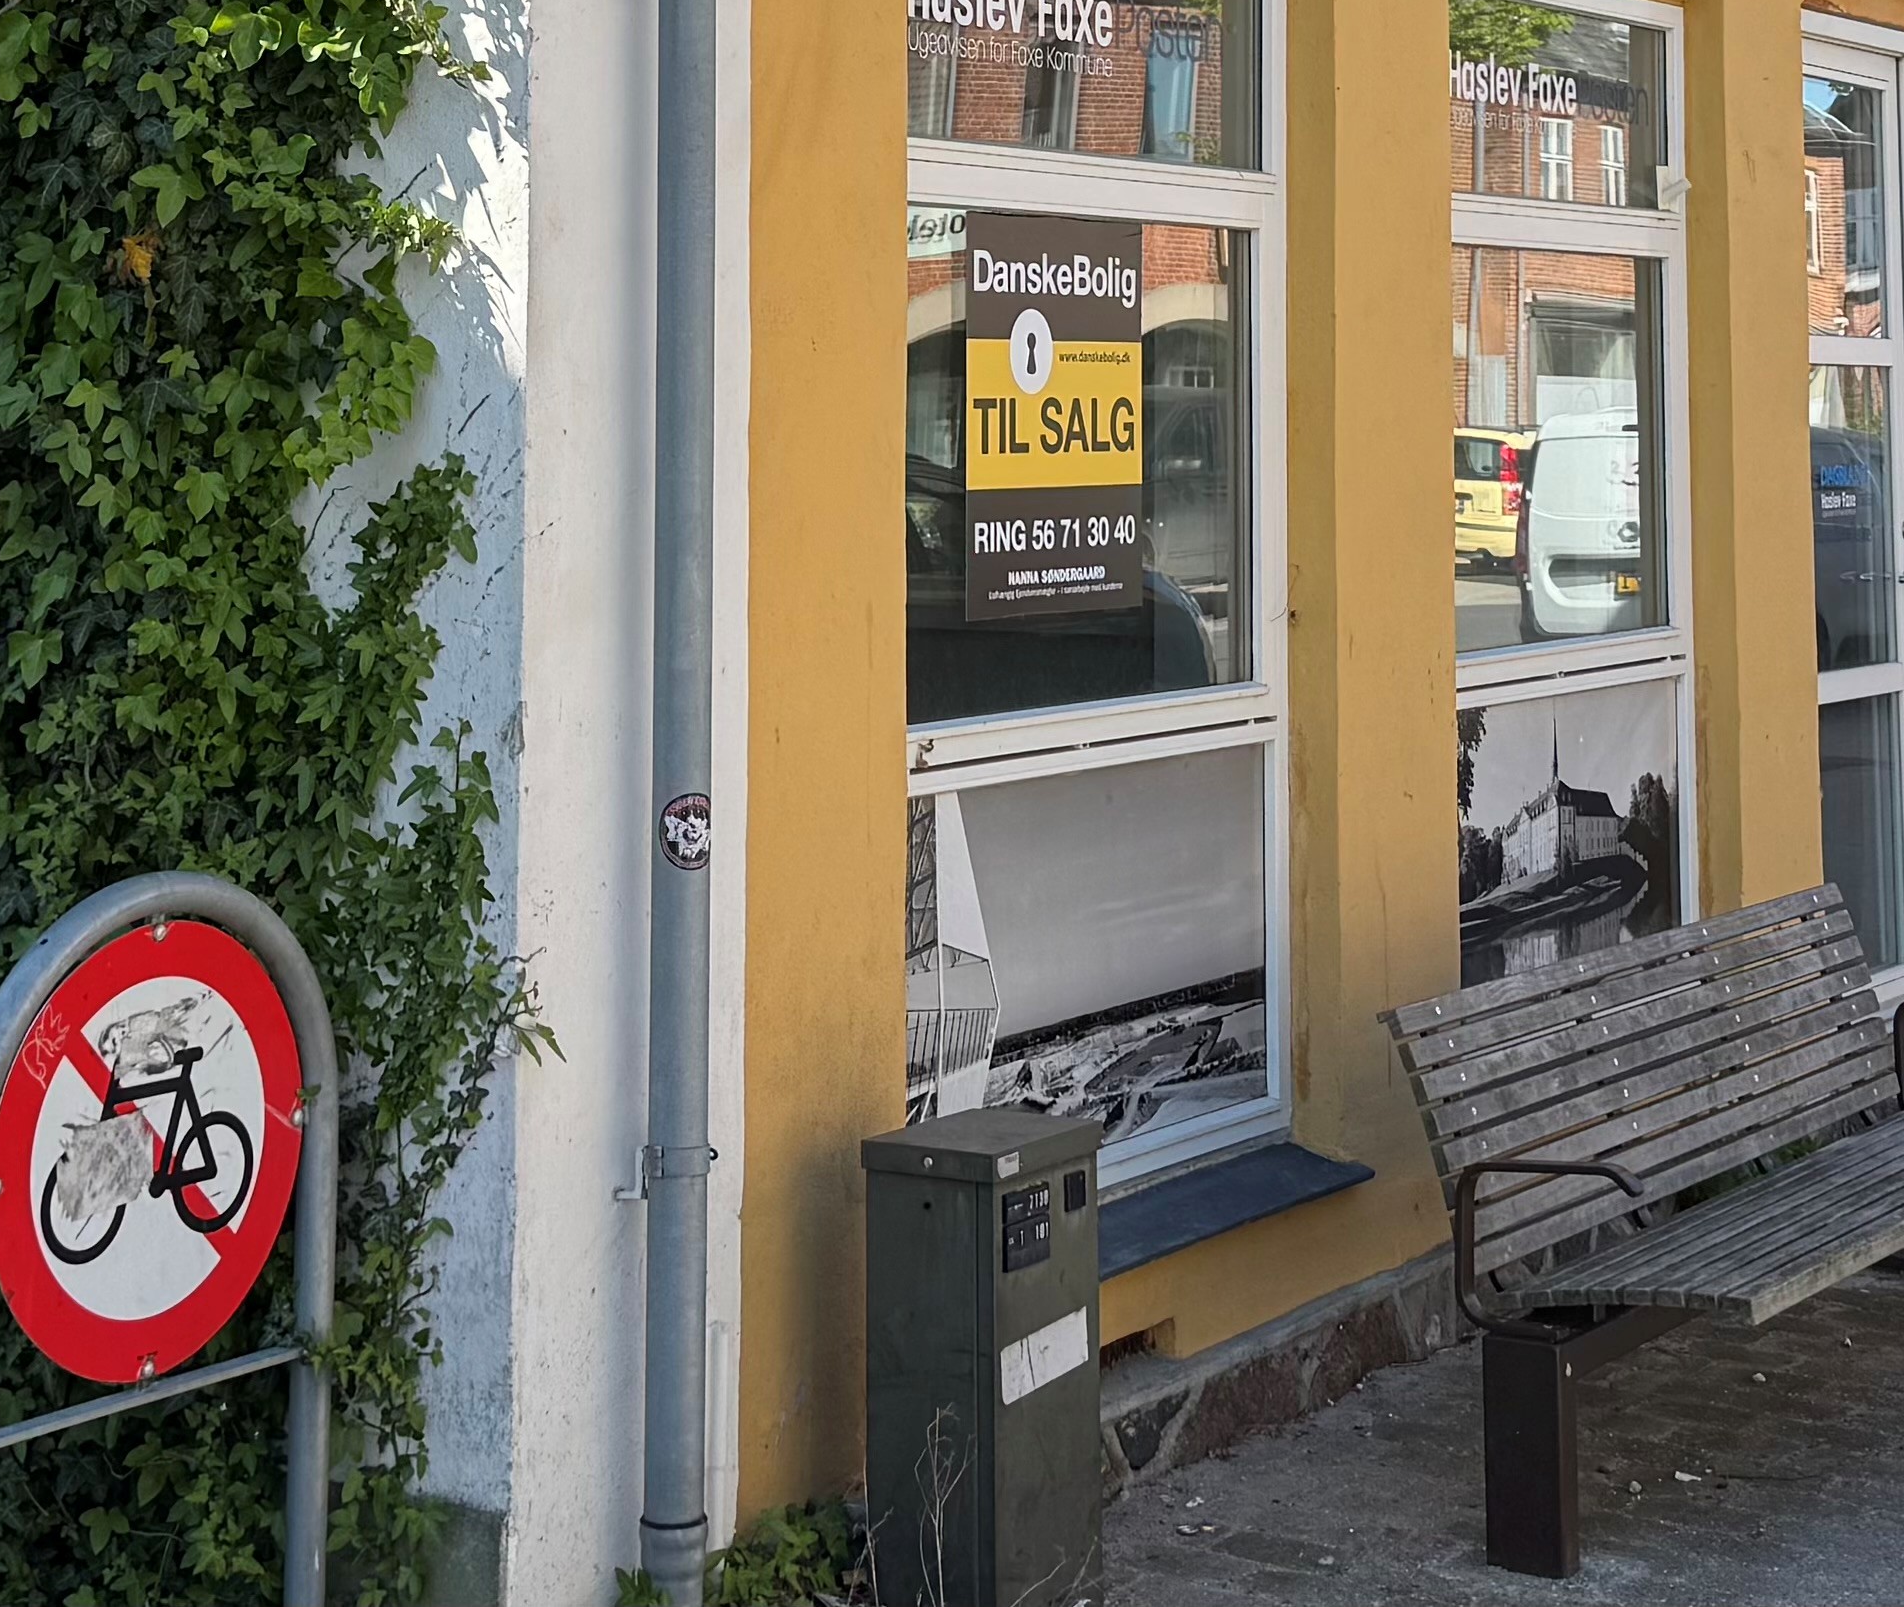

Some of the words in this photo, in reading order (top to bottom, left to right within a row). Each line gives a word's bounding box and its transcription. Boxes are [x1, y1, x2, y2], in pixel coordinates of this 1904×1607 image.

[908, 22, 986, 60] Ugeavisen
[990, 36, 1008, 63] for
[1012, 40, 1044, 68] Faxe
[1047, 45, 1114, 78] Kommune
[1449, 50, 1522, 107] Haslev
[1528, 62, 1577, 116] Faxe
[973, 249, 1138, 309] DanskeBolig
[973, 397, 1030, 455] TIL
[1040, 396, 1135, 454] SALG
[974, 520, 1027, 554] RING
[1031, 519, 1056, 551] 56
[1060, 518, 1081, 549] 71
[1087, 516, 1110, 548] 30
[1114, 514, 1136, 545] 40
